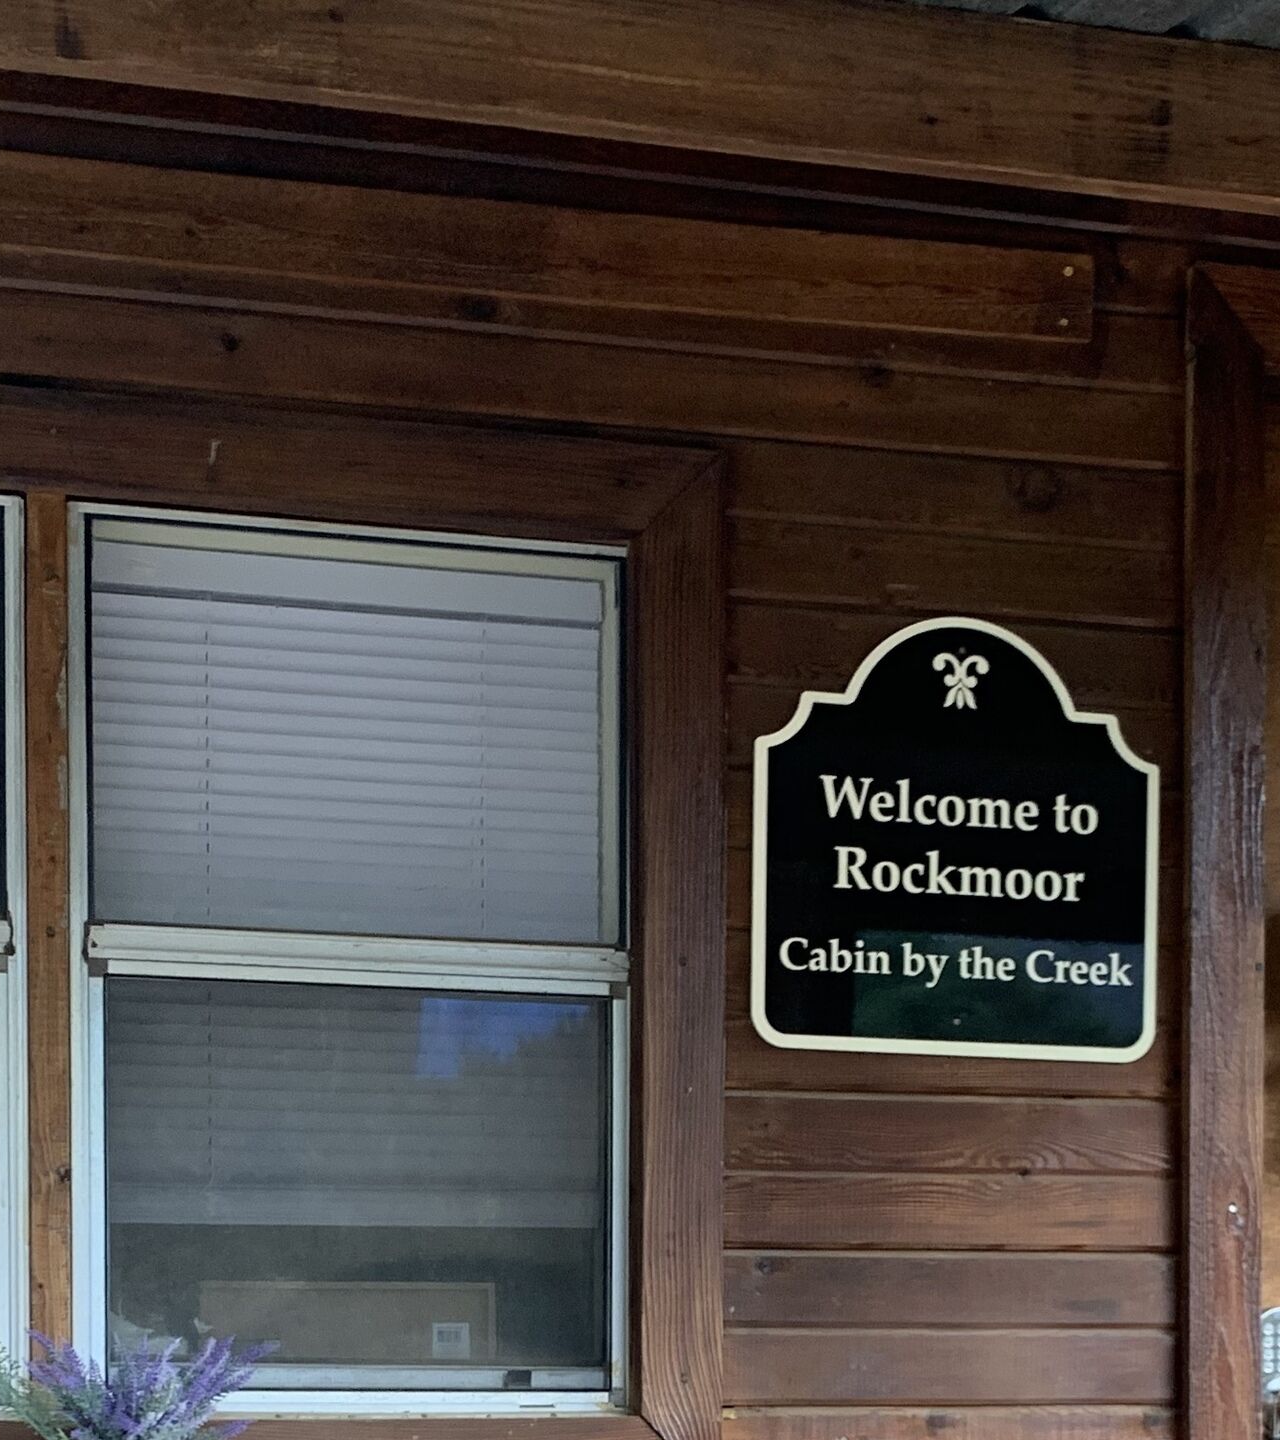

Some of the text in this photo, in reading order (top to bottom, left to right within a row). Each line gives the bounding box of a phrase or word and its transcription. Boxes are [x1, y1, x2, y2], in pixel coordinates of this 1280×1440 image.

[820, 774, 1099, 835] Welcome to
[833, 846, 1085, 902] Rockmoor
[779, 936, 1133, 988] Cabin by the Creek
